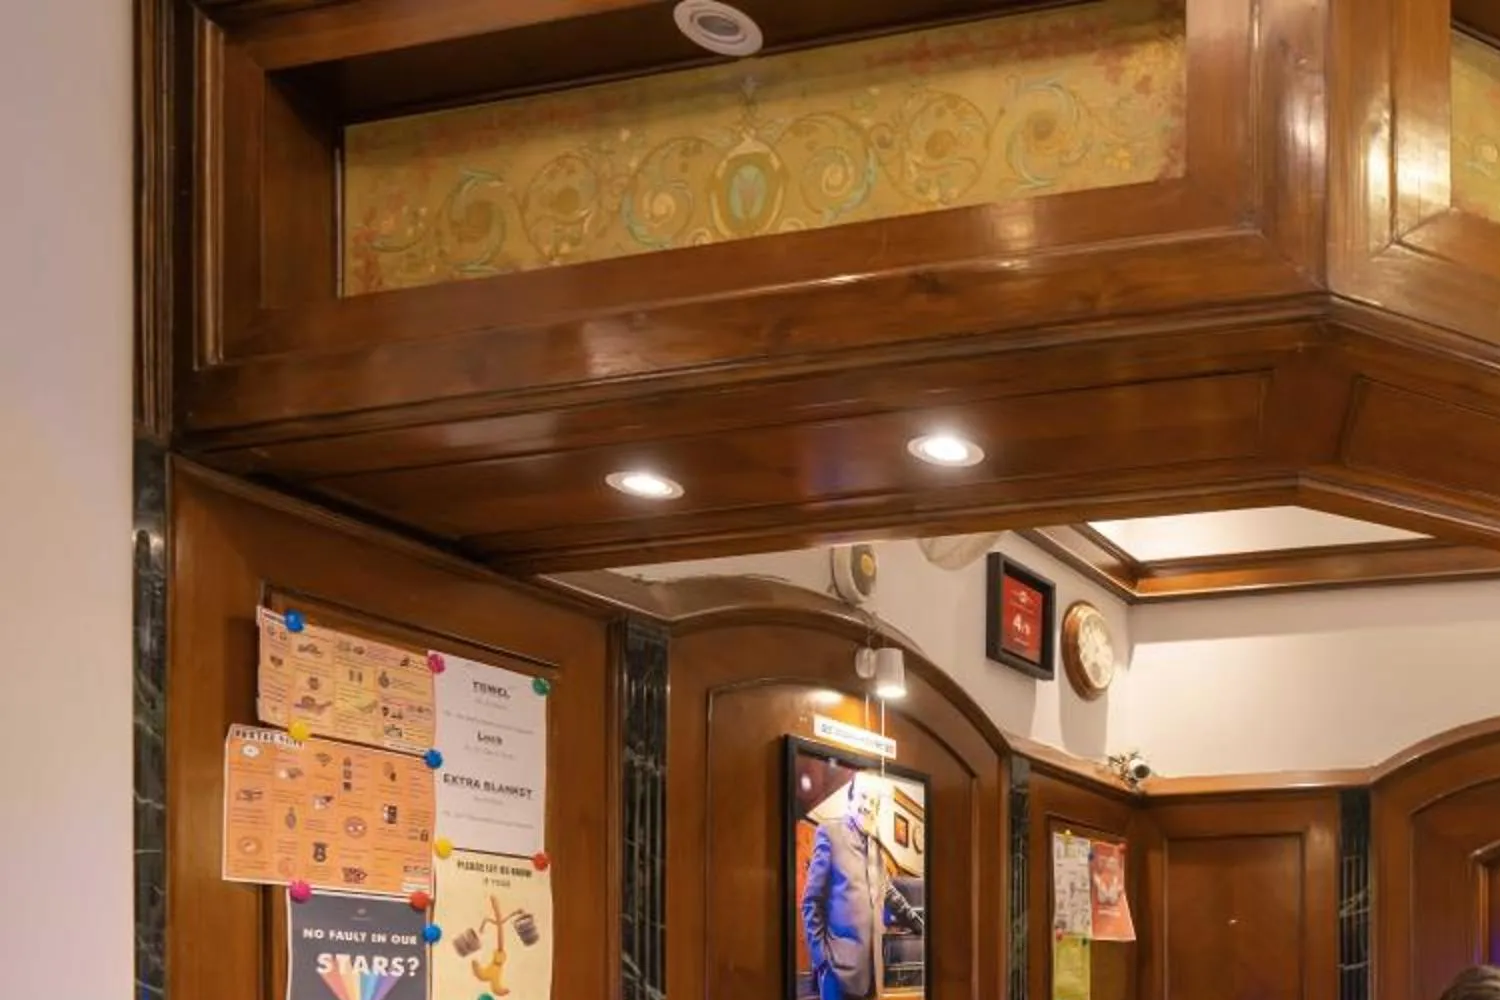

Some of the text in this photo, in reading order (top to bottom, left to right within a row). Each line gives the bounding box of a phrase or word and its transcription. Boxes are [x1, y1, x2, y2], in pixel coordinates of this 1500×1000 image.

[443, 773, 533, 799] EXTRA BLANKET
[303, 928, 417, 945] NO FAULT IN OUR
[316, 952, 420, 977] STARS?
